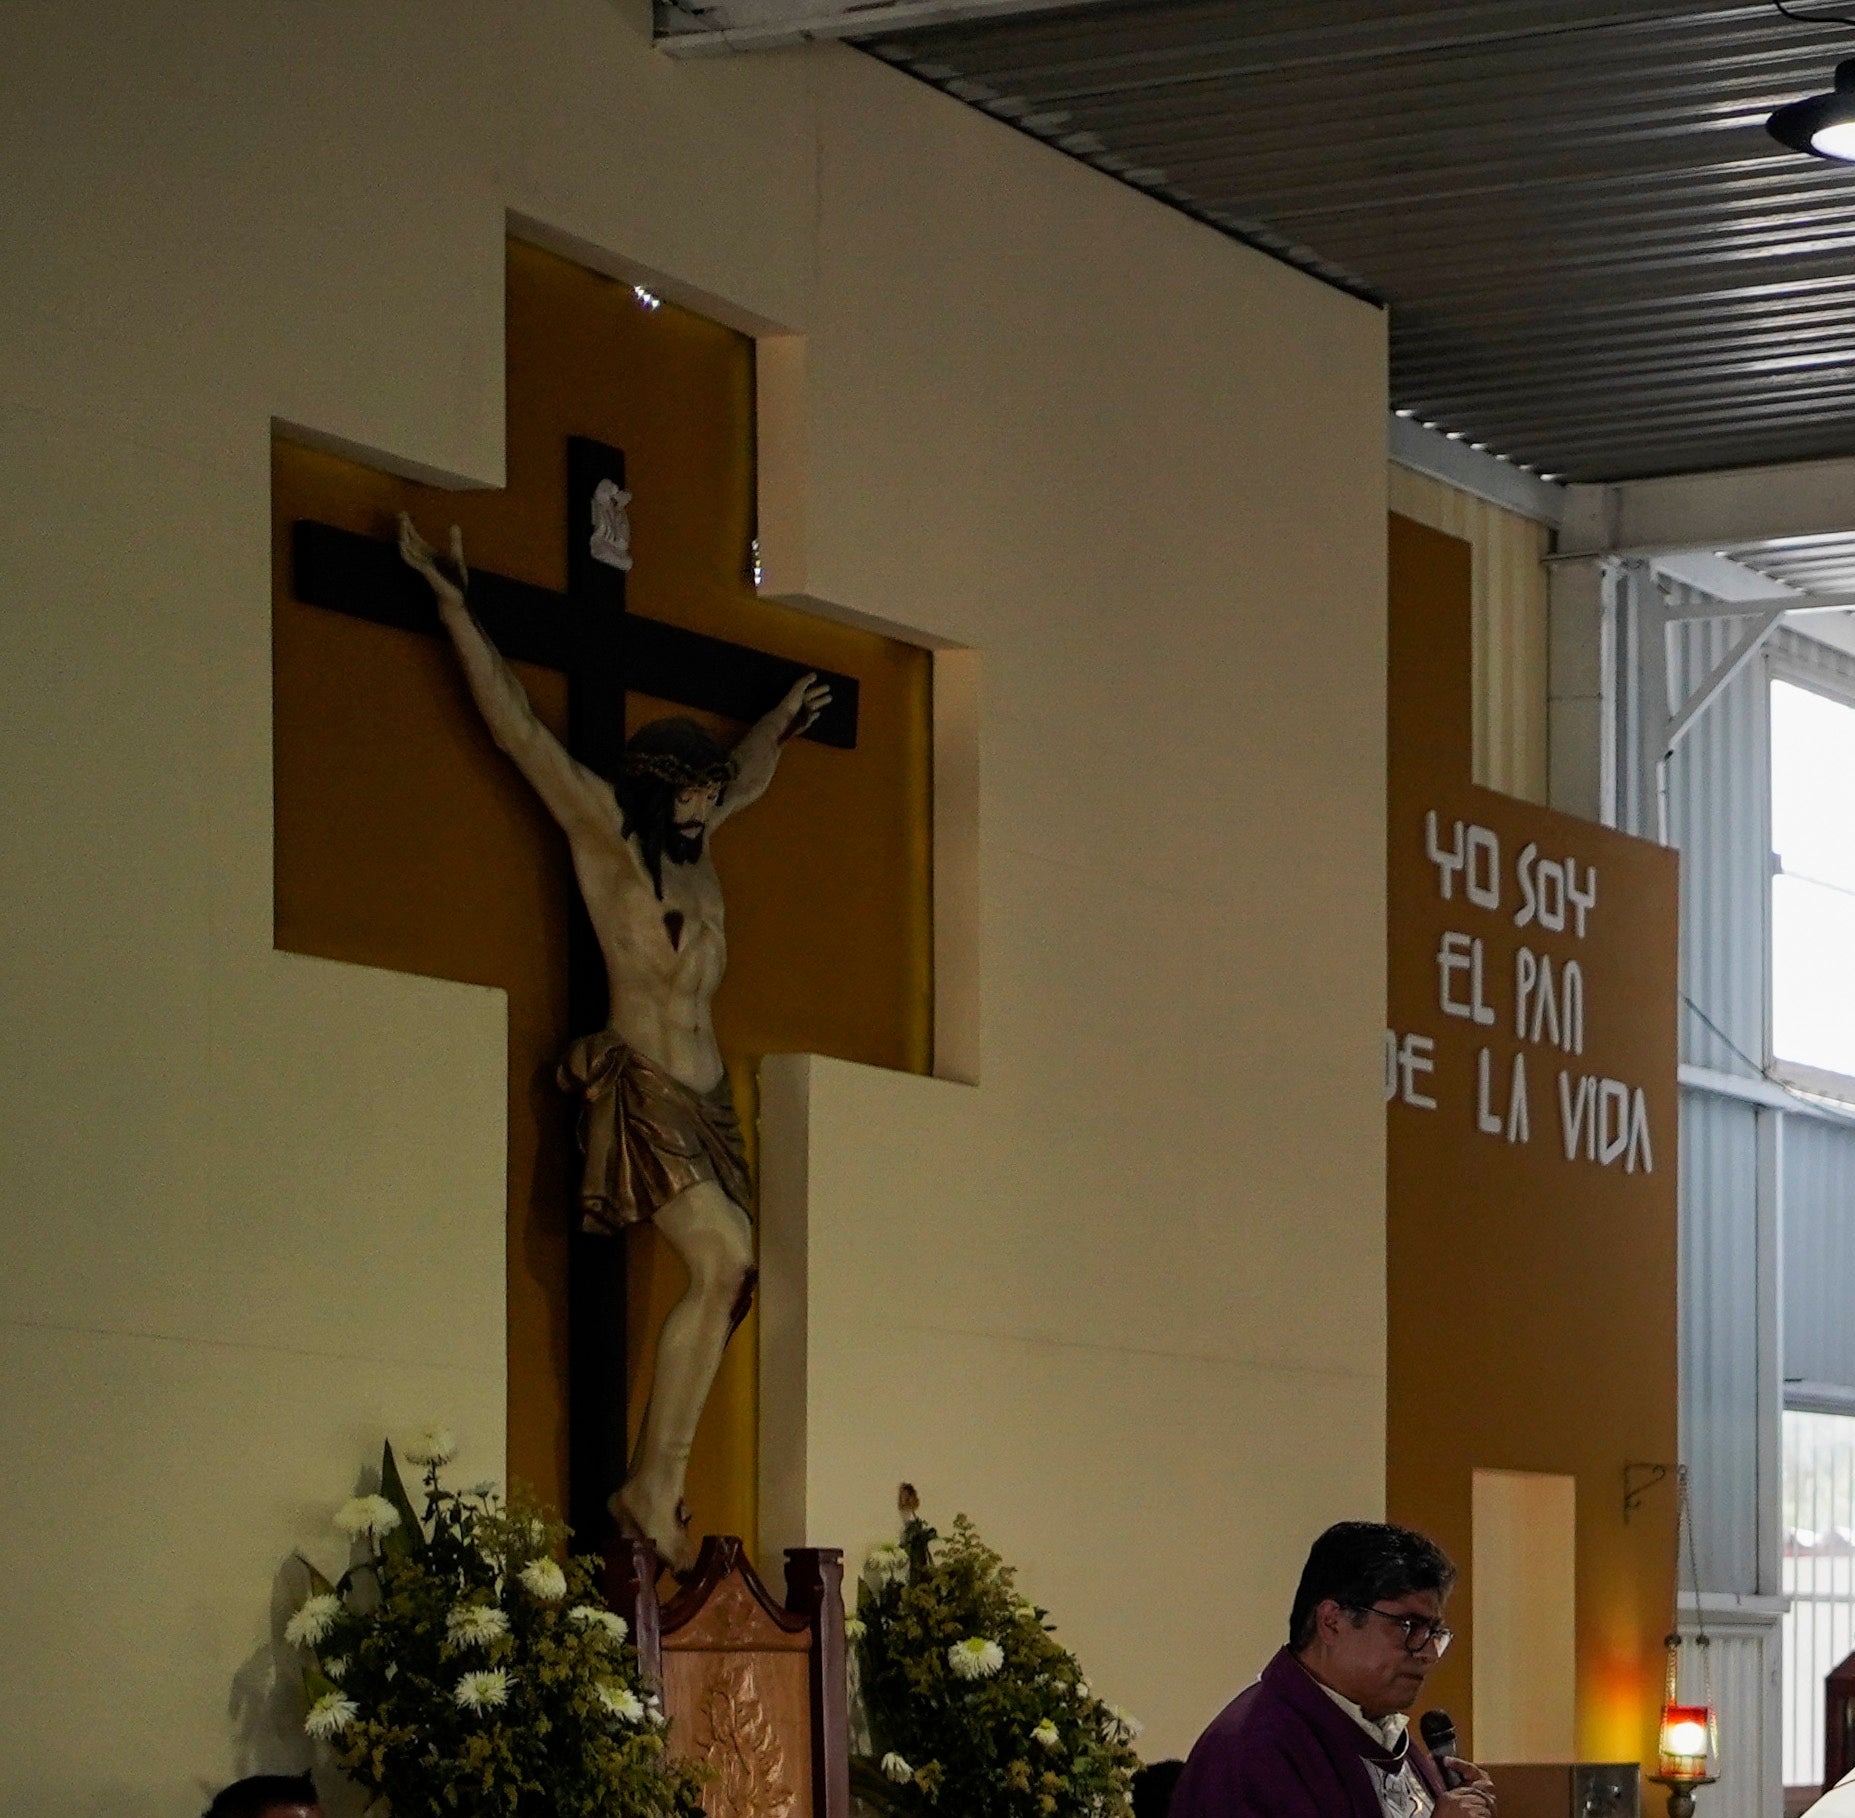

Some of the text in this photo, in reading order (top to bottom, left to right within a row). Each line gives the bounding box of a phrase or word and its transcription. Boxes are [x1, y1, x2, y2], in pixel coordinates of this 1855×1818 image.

[1425, 808, 1598, 939] YO SOY
[1436, 930, 1585, 1056] EL PAN
[1477, 1046, 1530, 1144] LA
[1557, 1069, 1654, 1175] VIDA
